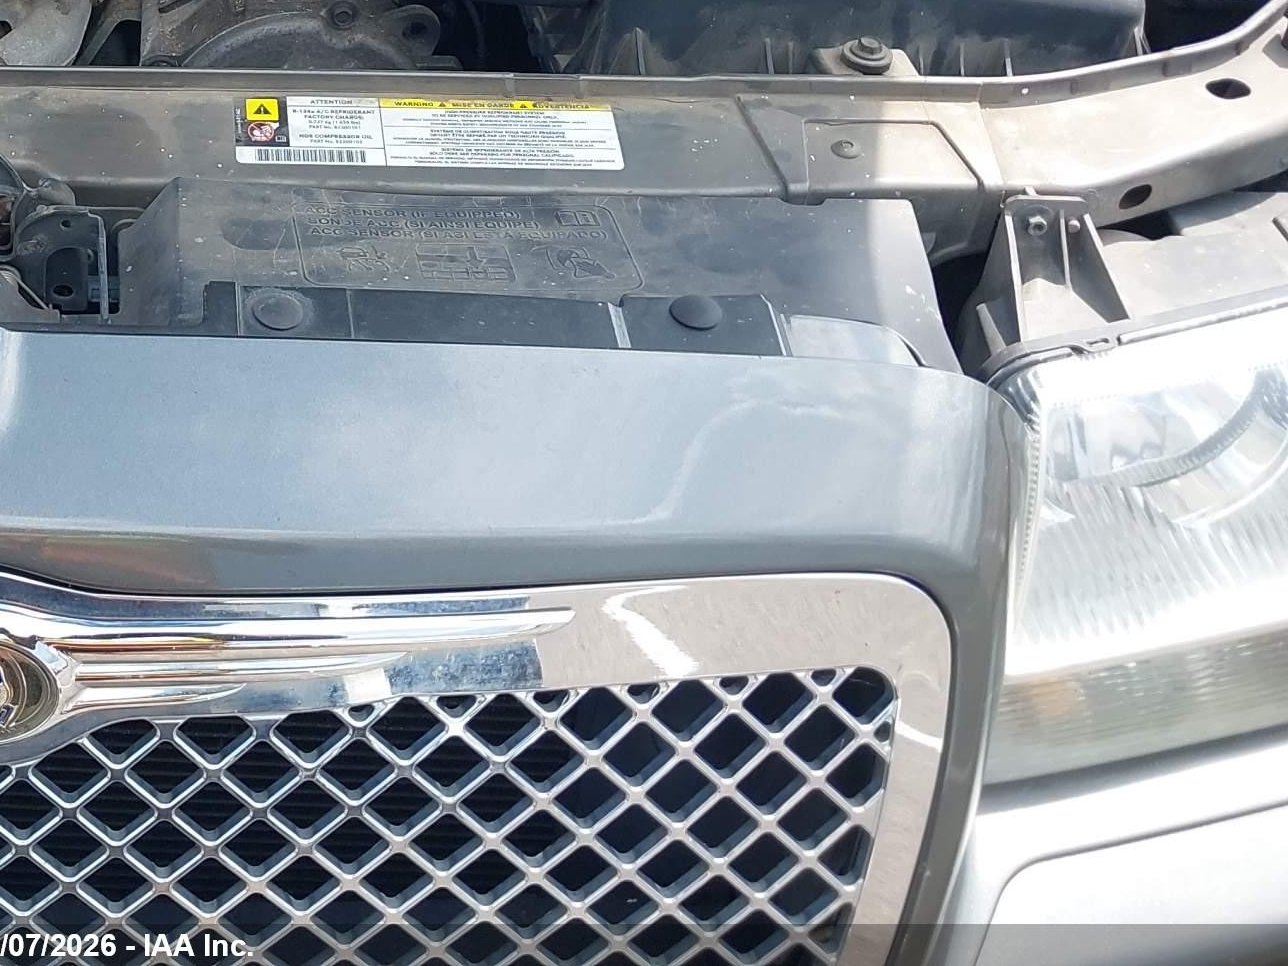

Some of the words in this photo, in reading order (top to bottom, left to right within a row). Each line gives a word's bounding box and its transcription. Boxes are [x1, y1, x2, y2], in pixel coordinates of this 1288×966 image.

[306, 206, 337, 215] ACC
[342, 208, 406, 218] SENSOR
[434, 211, 521, 220] EQUIPPED)
[367, 219, 401, 228] ACC
[404, 220, 424, 229] (SI
[428, 220, 472, 229] AINSI
[310, 226, 344, 236] ACC
[348, 229, 415, 238] SENSOR
[519, 230, 608, 240] EQUIPADO)
